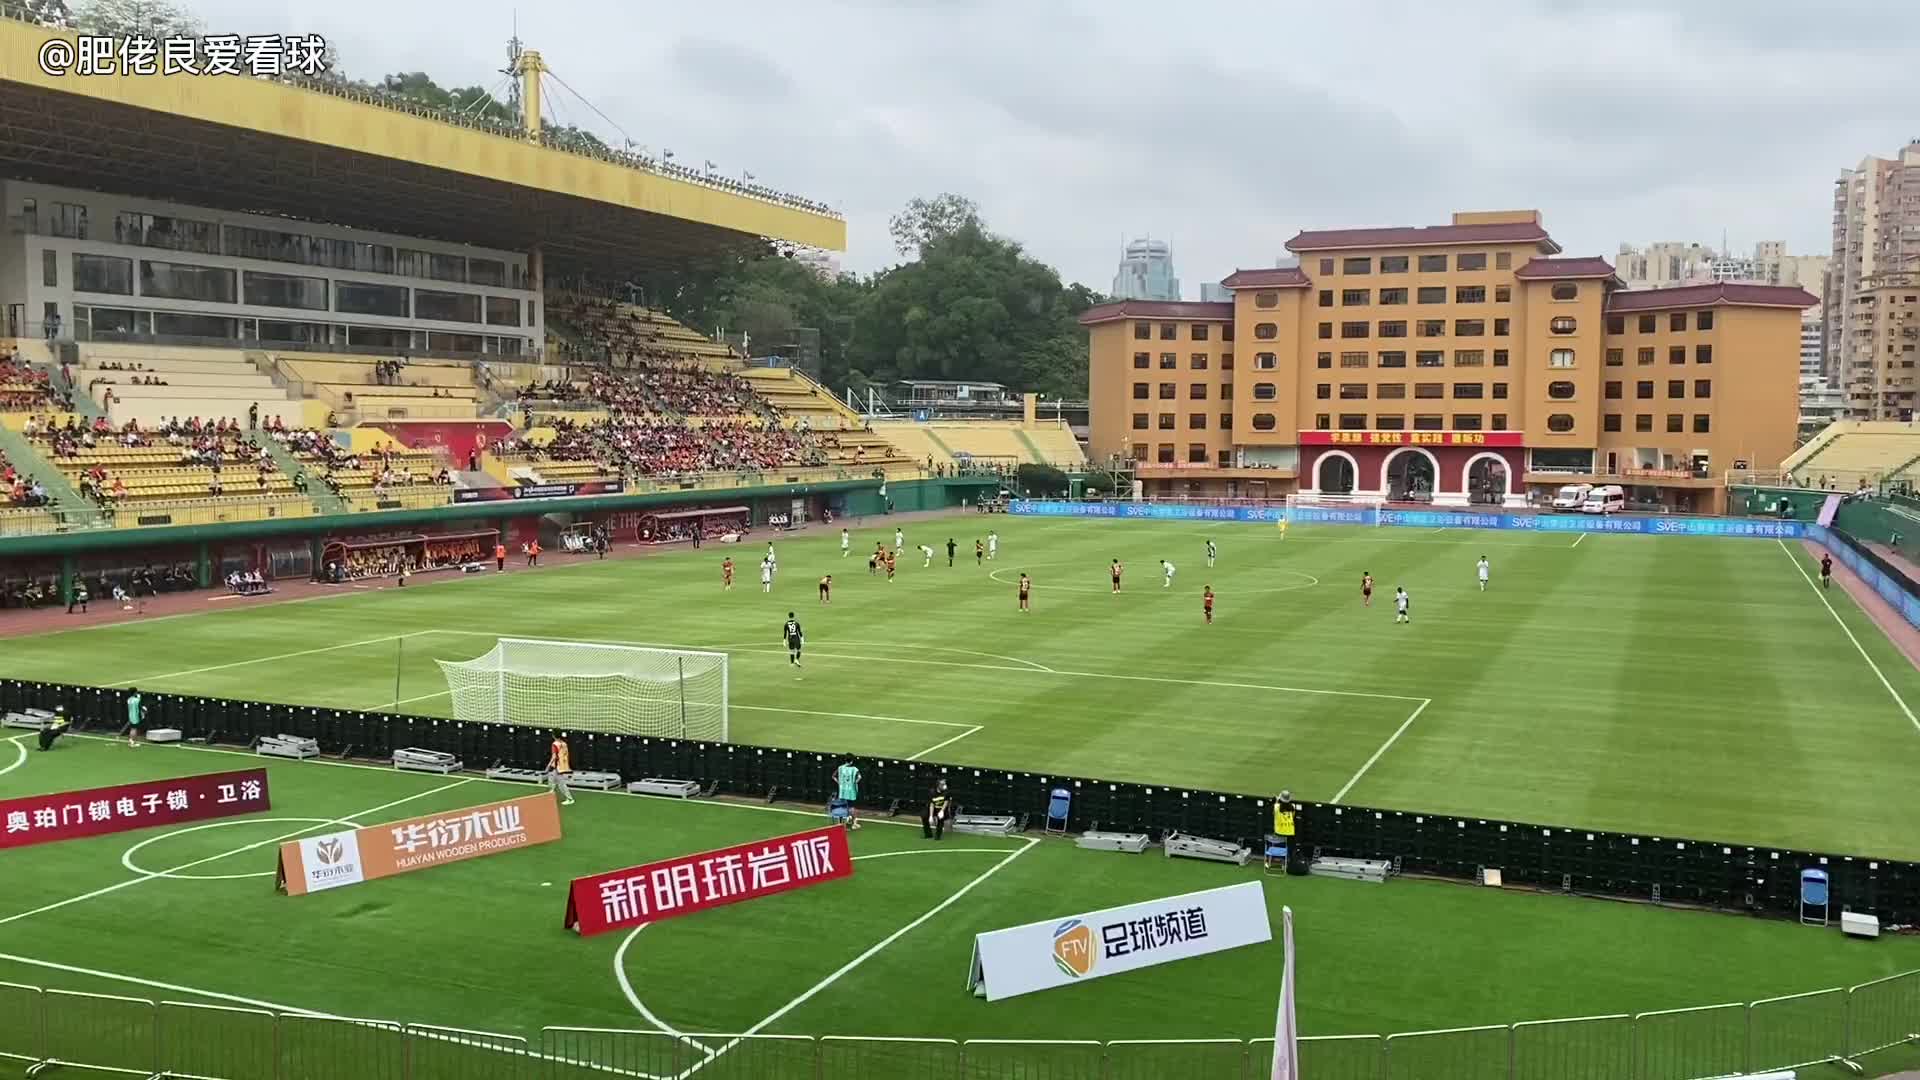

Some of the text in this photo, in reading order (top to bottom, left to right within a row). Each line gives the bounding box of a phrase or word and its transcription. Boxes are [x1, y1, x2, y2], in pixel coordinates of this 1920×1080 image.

[391, 805, 525, 853] 华衍木业
[396, 832, 528, 869] HUAYAN WOODEN PRODUCTS
[599, 835, 835, 924] 新明珠岩板
[1061, 938, 1088, 960] FTV
[1102, 906, 1209, 960] 足球频道
